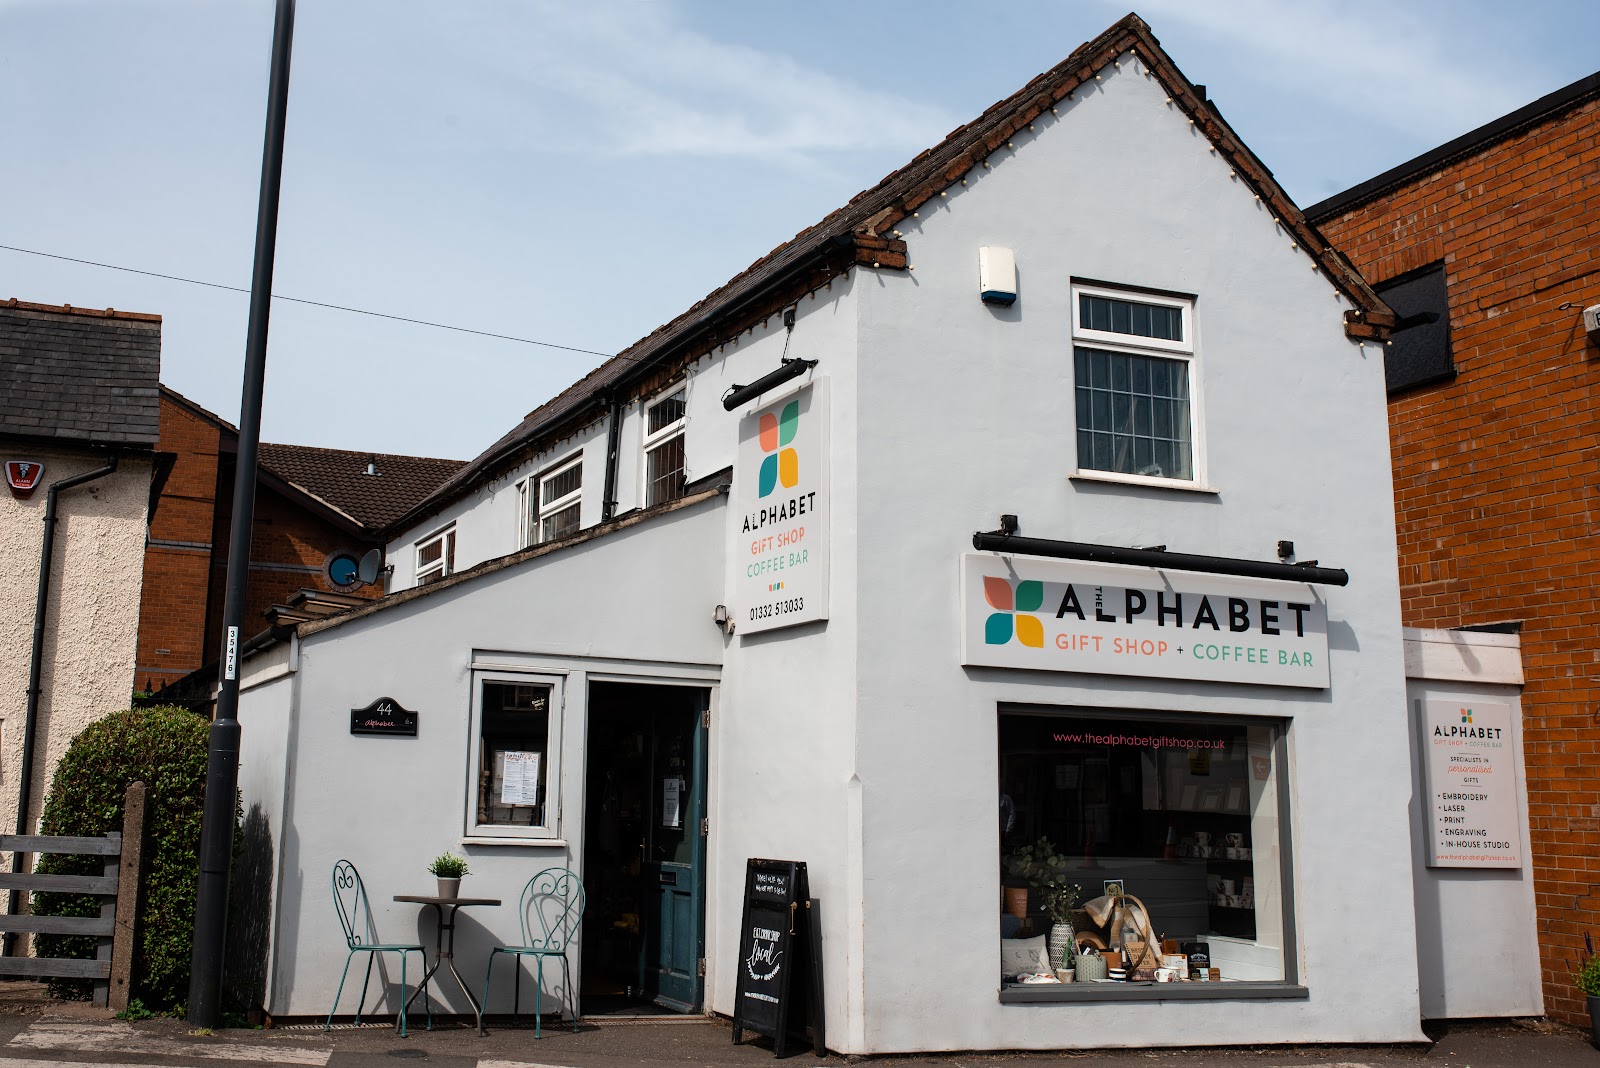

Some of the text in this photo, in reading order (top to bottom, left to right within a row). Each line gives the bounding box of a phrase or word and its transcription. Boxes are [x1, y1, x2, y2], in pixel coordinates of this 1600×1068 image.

[742, 491, 816, 534] ALPHABET
[751, 526, 805, 555] GIFT SHOP
[746, 549, 808, 578] COFFEE BAR
[750, 596, 804, 620] 01332 513033
[1095, 586, 1103, 608] THE
[1056, 584, 1310, 638] ALPHABET
[1055, 633, 1104, 652] GIFT
[1113, 637, 1168, 656] SHOP
[1192, 643, 1269, 664] COFFEE
[1278, 649, 1314, 668] BAR
[376, 702, 392, 716] 44
[1052, 732, 1226, 750] www.thealphabetgiftshop.co.uk
[1434, 725, 1502, 740] ALPHABET
[1448, 764, 1492, 774] personalised
[1442, 792, 1488, 801] EMBROIDERY
[1445, 828, 1487, 836] ENGRAVING
[746, 939, 783, 966] local
